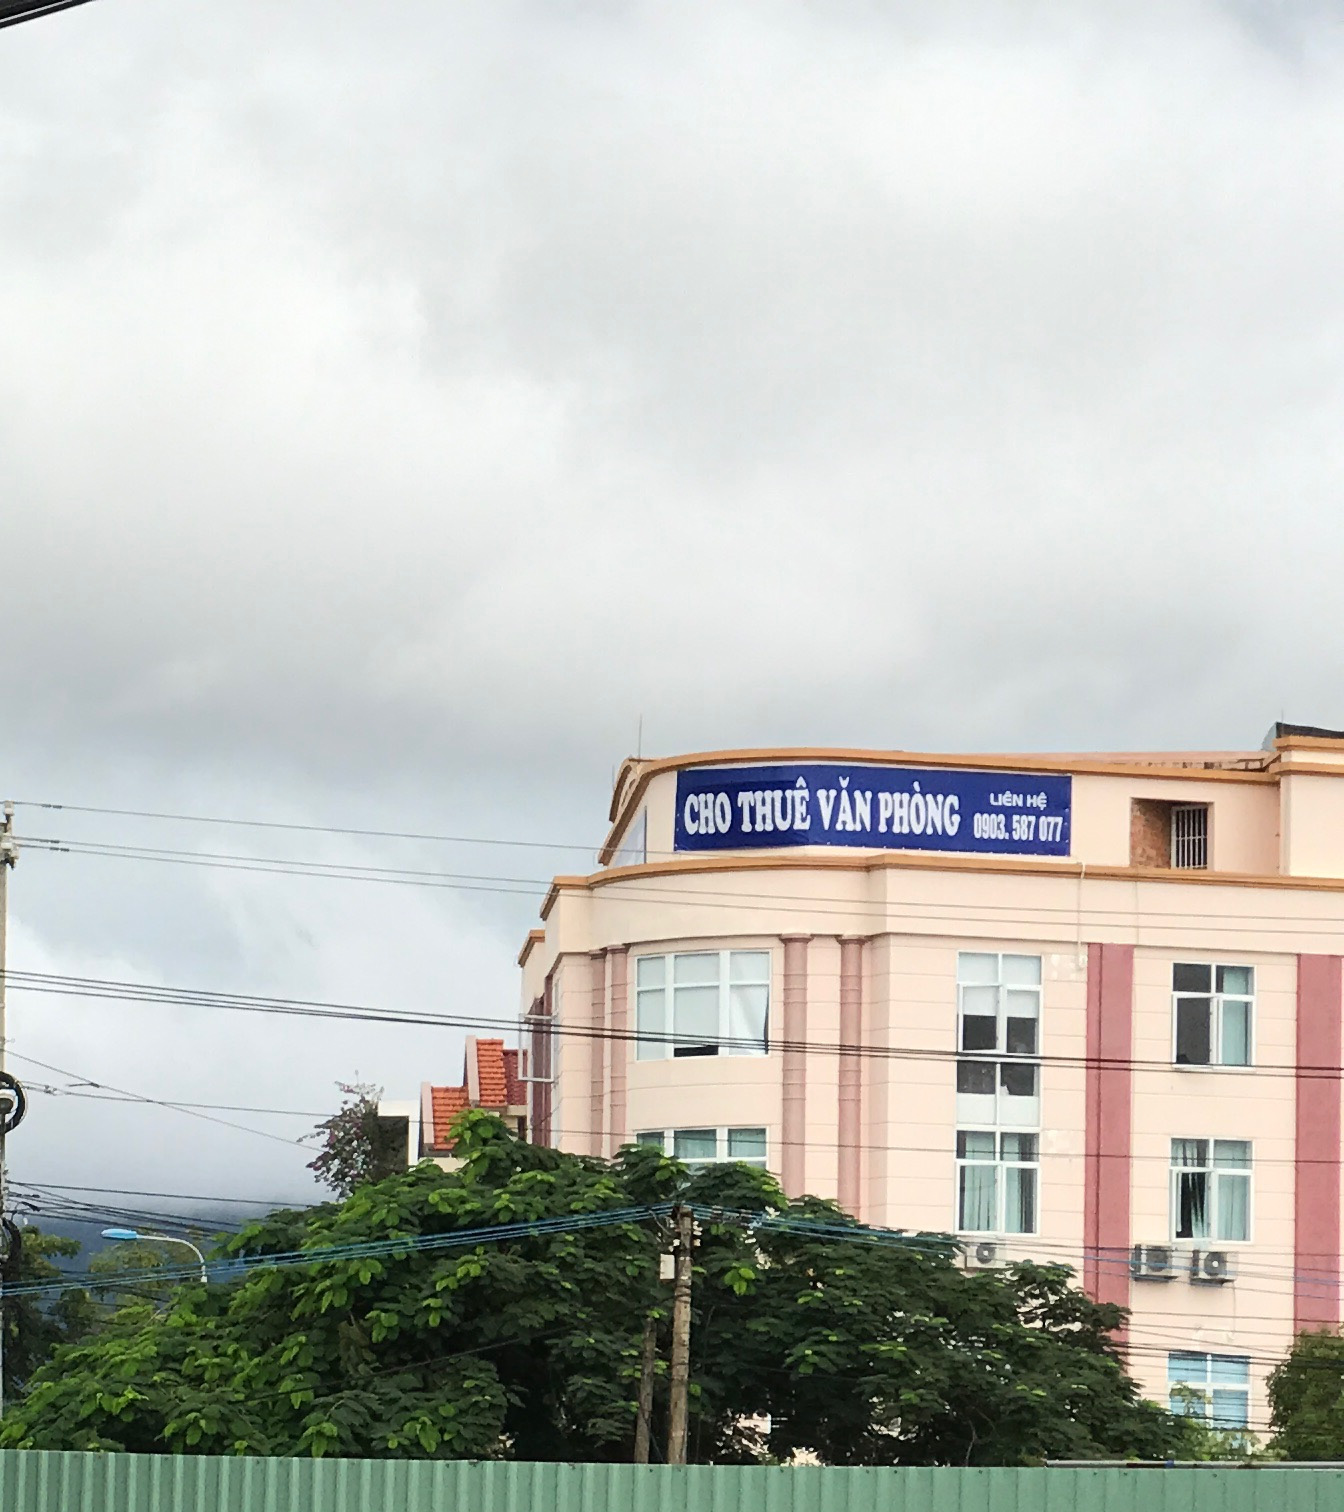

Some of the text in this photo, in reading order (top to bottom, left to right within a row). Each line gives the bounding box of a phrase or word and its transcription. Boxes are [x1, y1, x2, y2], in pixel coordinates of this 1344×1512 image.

[684, 776, 961, 837] CHO THUÊ VĂN PHÒNG
[989, 790, 1048, 810] LIÊN HỆ
[973, 812, 1064, 842] 0903. 587 077
